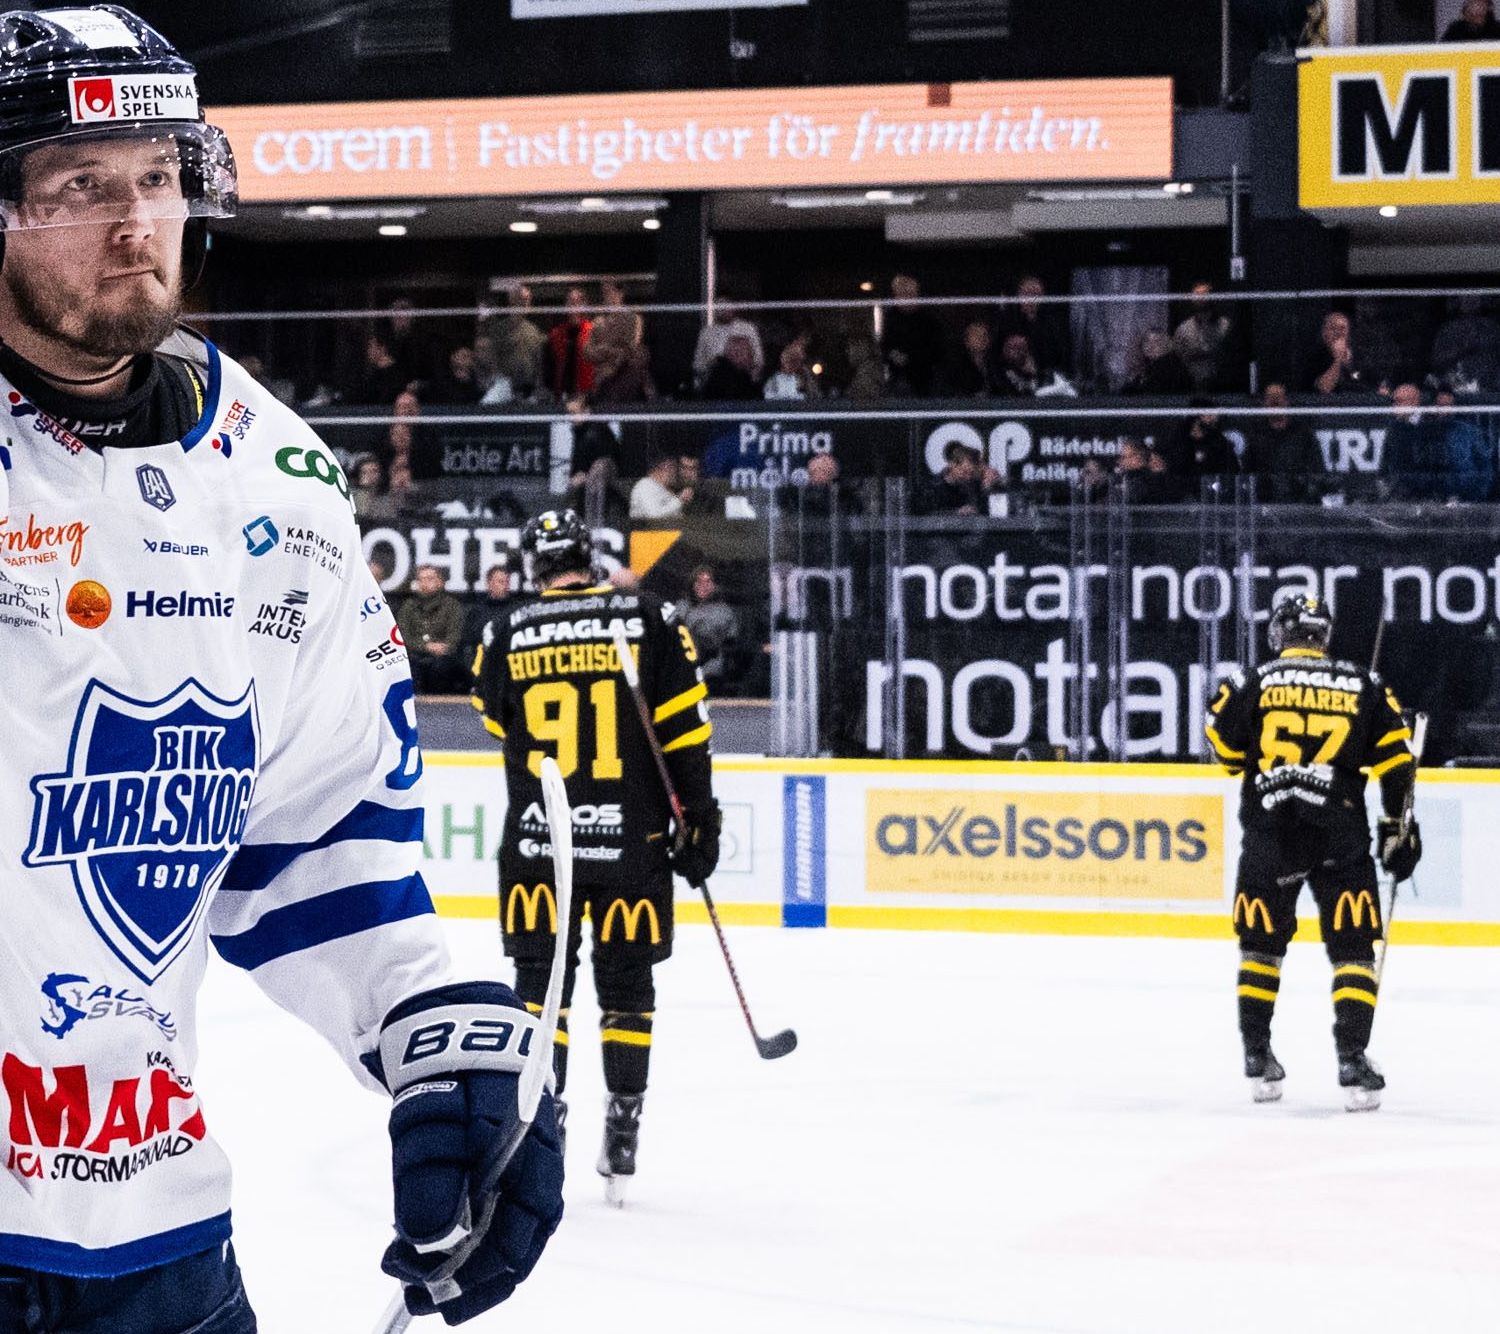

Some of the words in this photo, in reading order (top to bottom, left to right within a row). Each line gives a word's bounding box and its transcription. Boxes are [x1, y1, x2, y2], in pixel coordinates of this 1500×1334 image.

[120, 83, 194, 101] SVENSKA
[122, 101, 165, 117] SPEL
[252, 118, 433, 175] corem
[476, 111, 749, 181] Fastigheter
[767, 109, 836, 162] för
[849, 103, 1113, 164] framtiden.
[740, 423, 833, 456] Prima
[159, 541, 209, 557] BAUER
[895, 553, 1107, 622] notar
[510, 617, 645, 651] ALFAGLAS
[507, 643, 640, 681] HUTCHISON
[866, 637, 1242, 757] notar
[1259, 685, 1360, 717] KOMAREK
[153, 725, 219, 773] BIK
[524, 679, 623, 781] 91
[1258, 710, 1351, 771] 67
[36, 773, 256, 861] KARLSKOG
[875, 802, 1208, 863] axelssons
[135, 862, 201, 890] 1978
